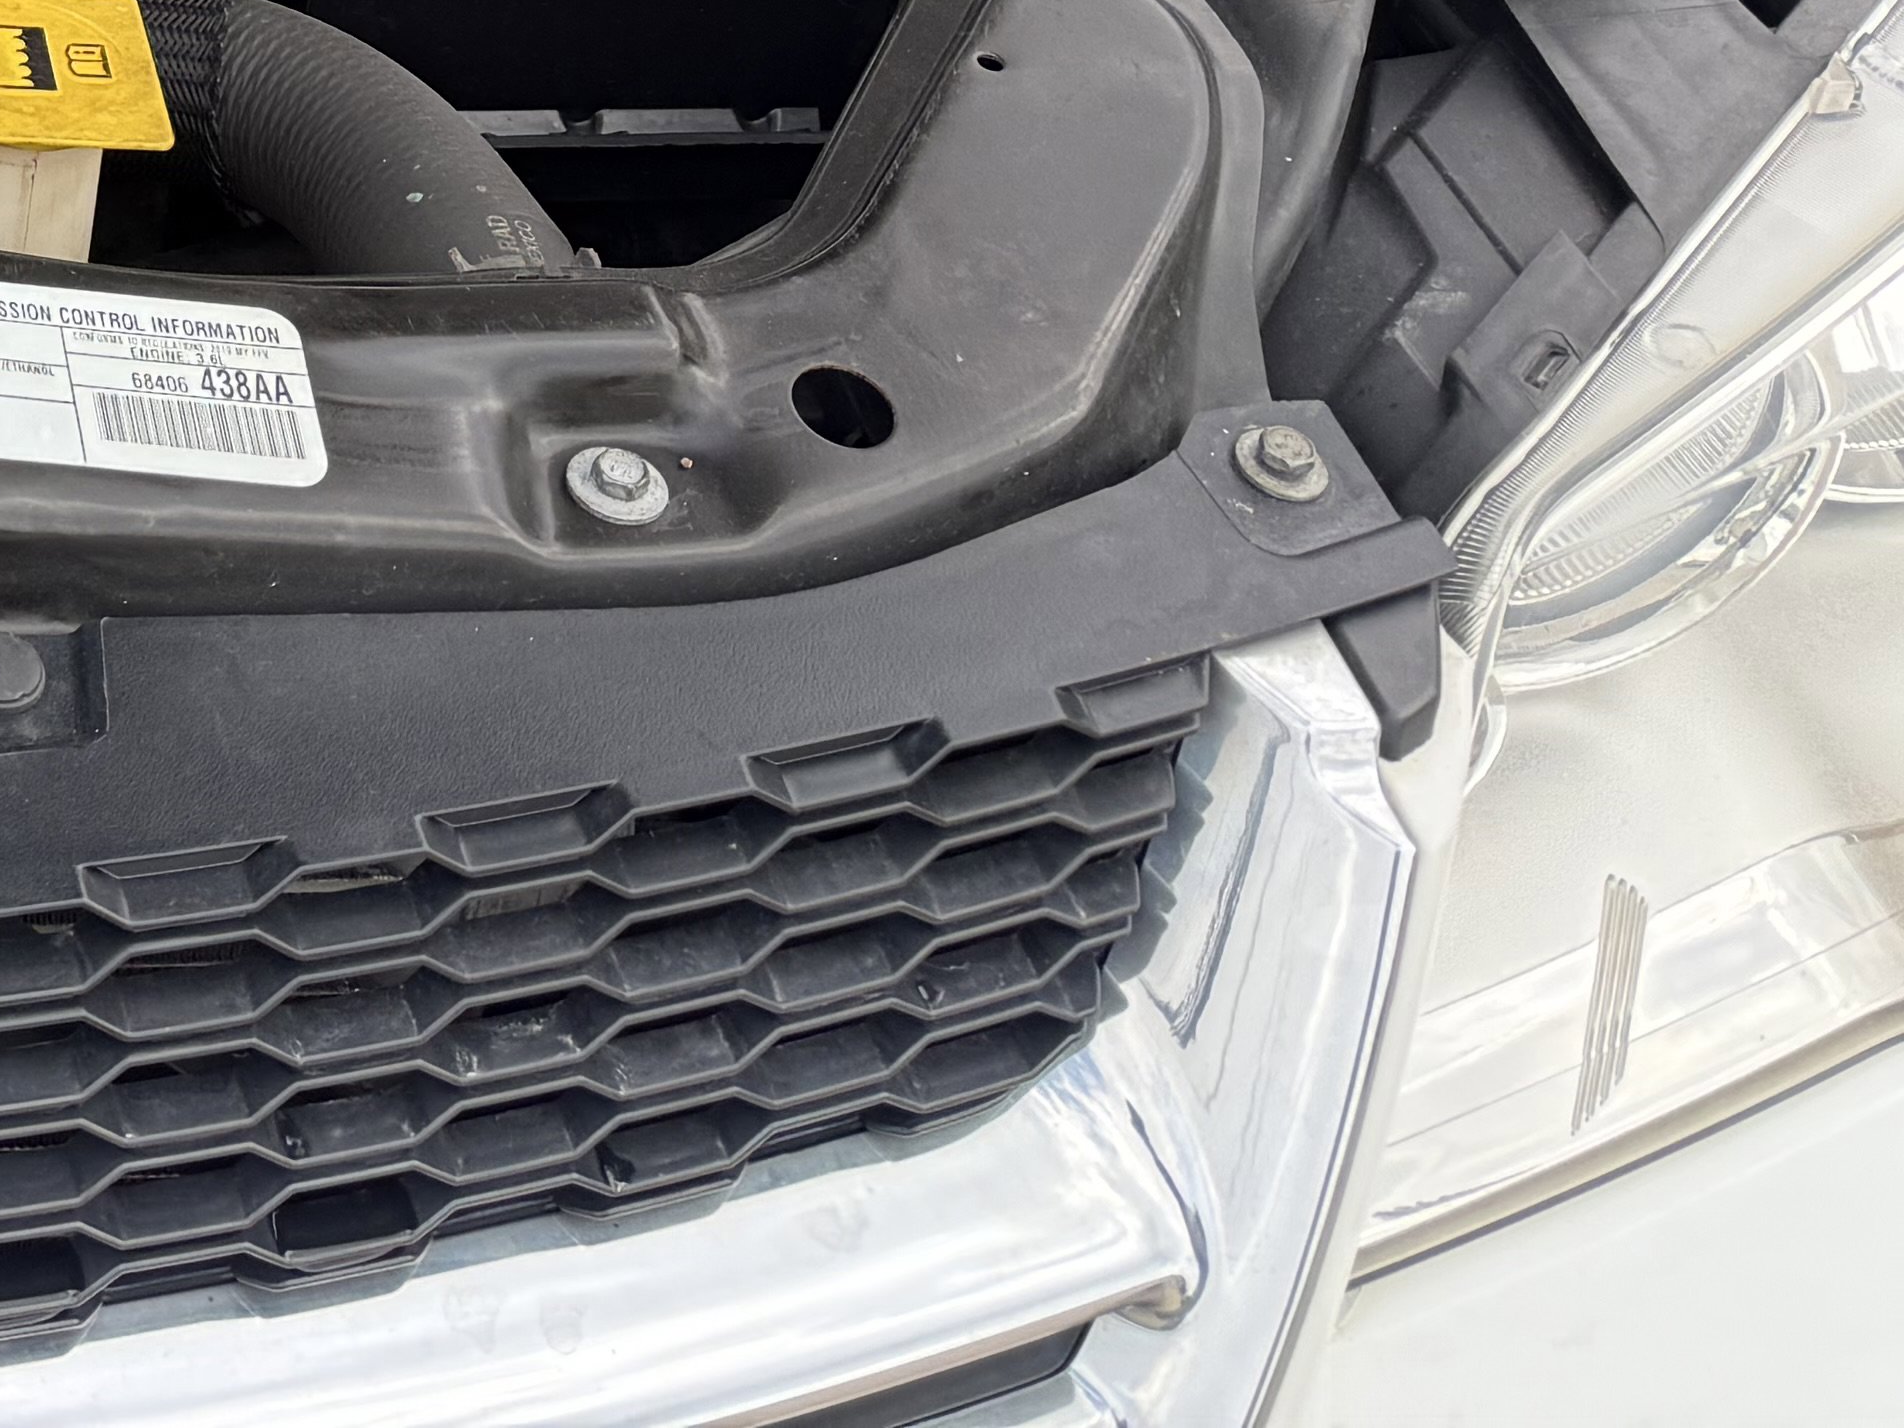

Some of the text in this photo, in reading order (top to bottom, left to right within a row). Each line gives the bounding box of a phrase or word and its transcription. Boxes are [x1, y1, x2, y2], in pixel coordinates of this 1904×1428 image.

[59, 307, 145, 332] CONTROL
[152, 316, 281, 344] INFORMATION
[132, 367, 293, 404] 68406 438AA
